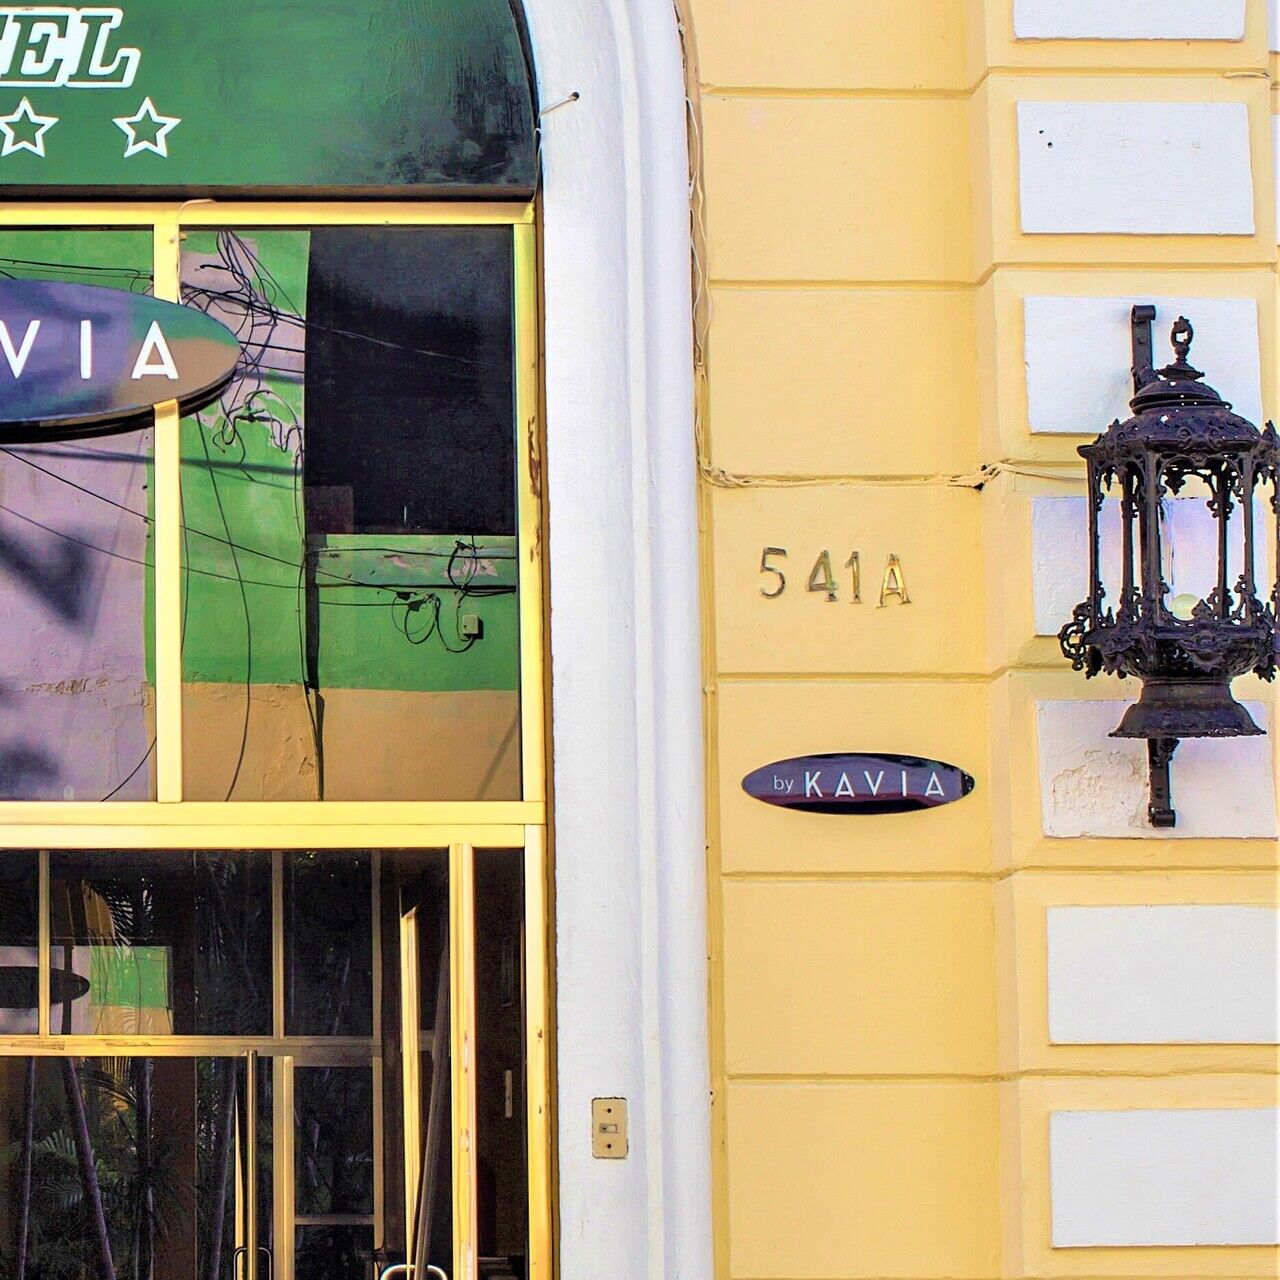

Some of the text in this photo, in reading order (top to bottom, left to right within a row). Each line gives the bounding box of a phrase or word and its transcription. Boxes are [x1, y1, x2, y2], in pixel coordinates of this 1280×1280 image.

[760, 546, 912, 608] 541A
[773, 770, 945, 798] by KAVIA
